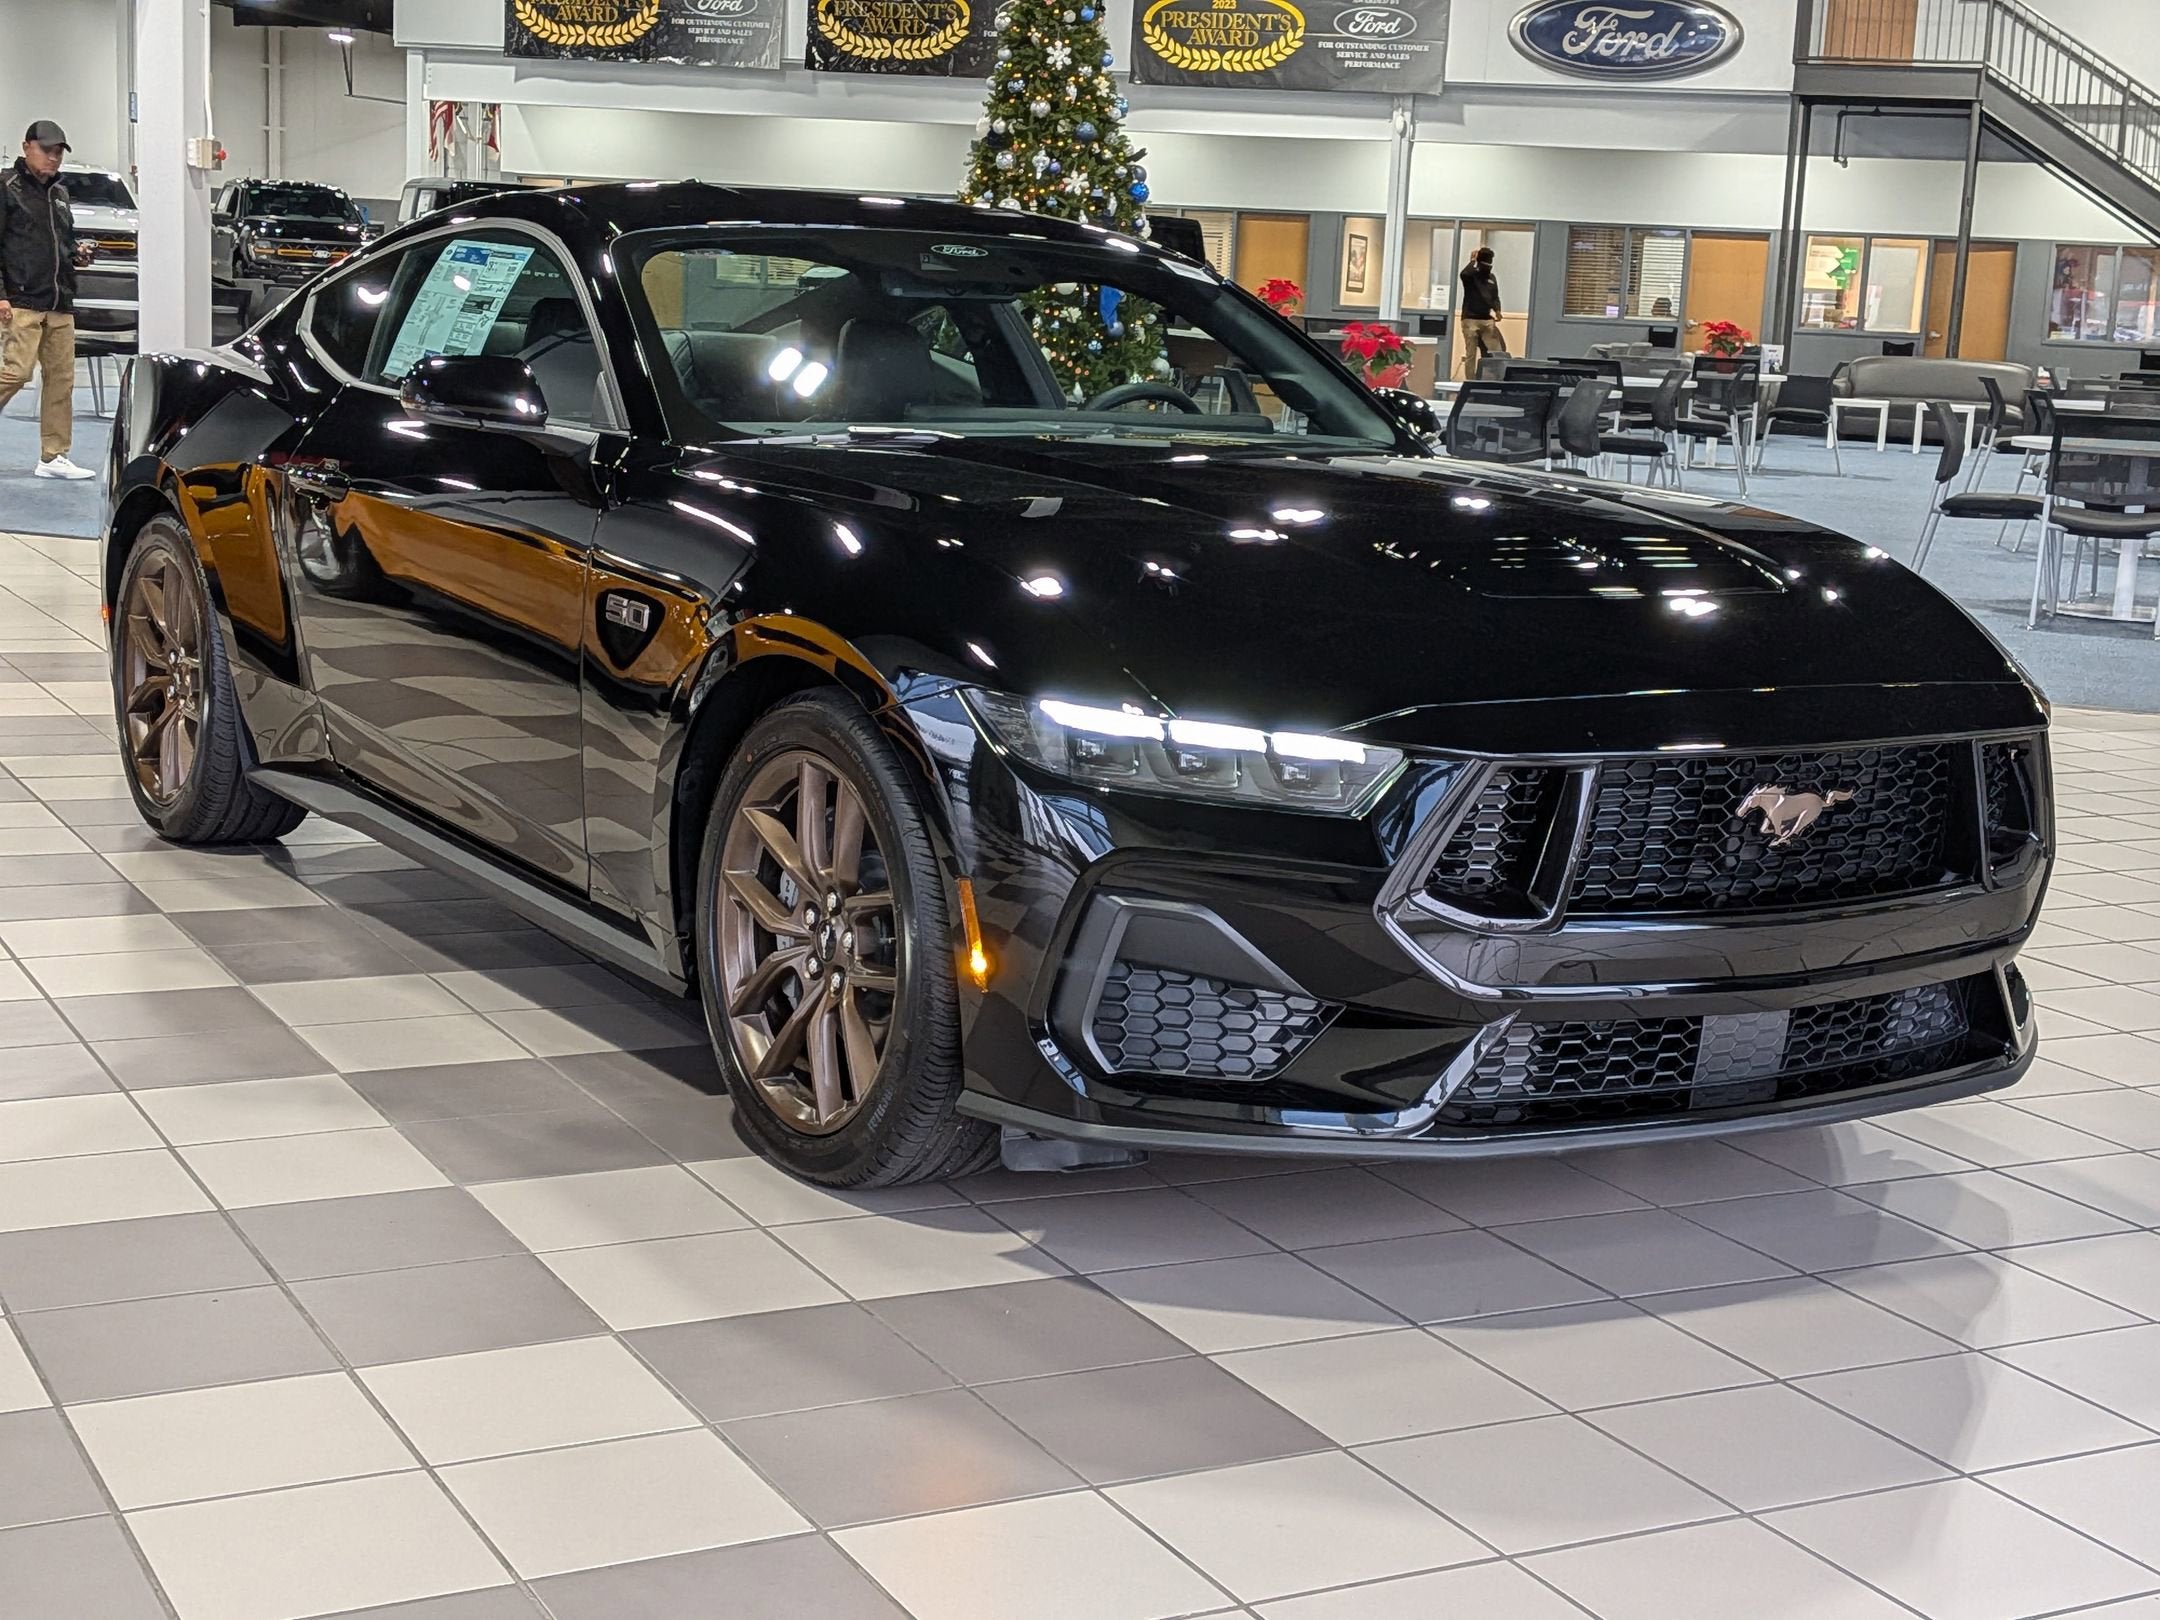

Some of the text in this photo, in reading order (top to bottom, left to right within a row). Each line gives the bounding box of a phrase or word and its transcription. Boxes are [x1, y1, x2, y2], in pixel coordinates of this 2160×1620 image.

[833, 0, 958, 21] PRESIDENT'S
[1212, 0, 1236, 9] 2023
[554, 5, 619, 23] AWARD
[1160, 11, 1292, 31] PRESIDENT'S
[686, 19, 732, 27] OUTSTANDING
[733, 21, 770, 29] CUSTOMER
[859, 17, 927, 36] AWARD
[1348, 10, 1402, 34] Ford
[1186, 29, 1259, 47] AWARD
[1562, 6, 1684, 57] Ford
[695, 36, 744, 44] PERFORMANCE
[1318, 41, 1430, 52] FOR OUTSTANDING CUSTOMER
[1336, 51, 1369, 59] SERVICE
[1370, 52, 1386, 60] AND
[1344, 60, 1401, 69] PERFORMANCE
[943, 245, 979, 256] Ford
